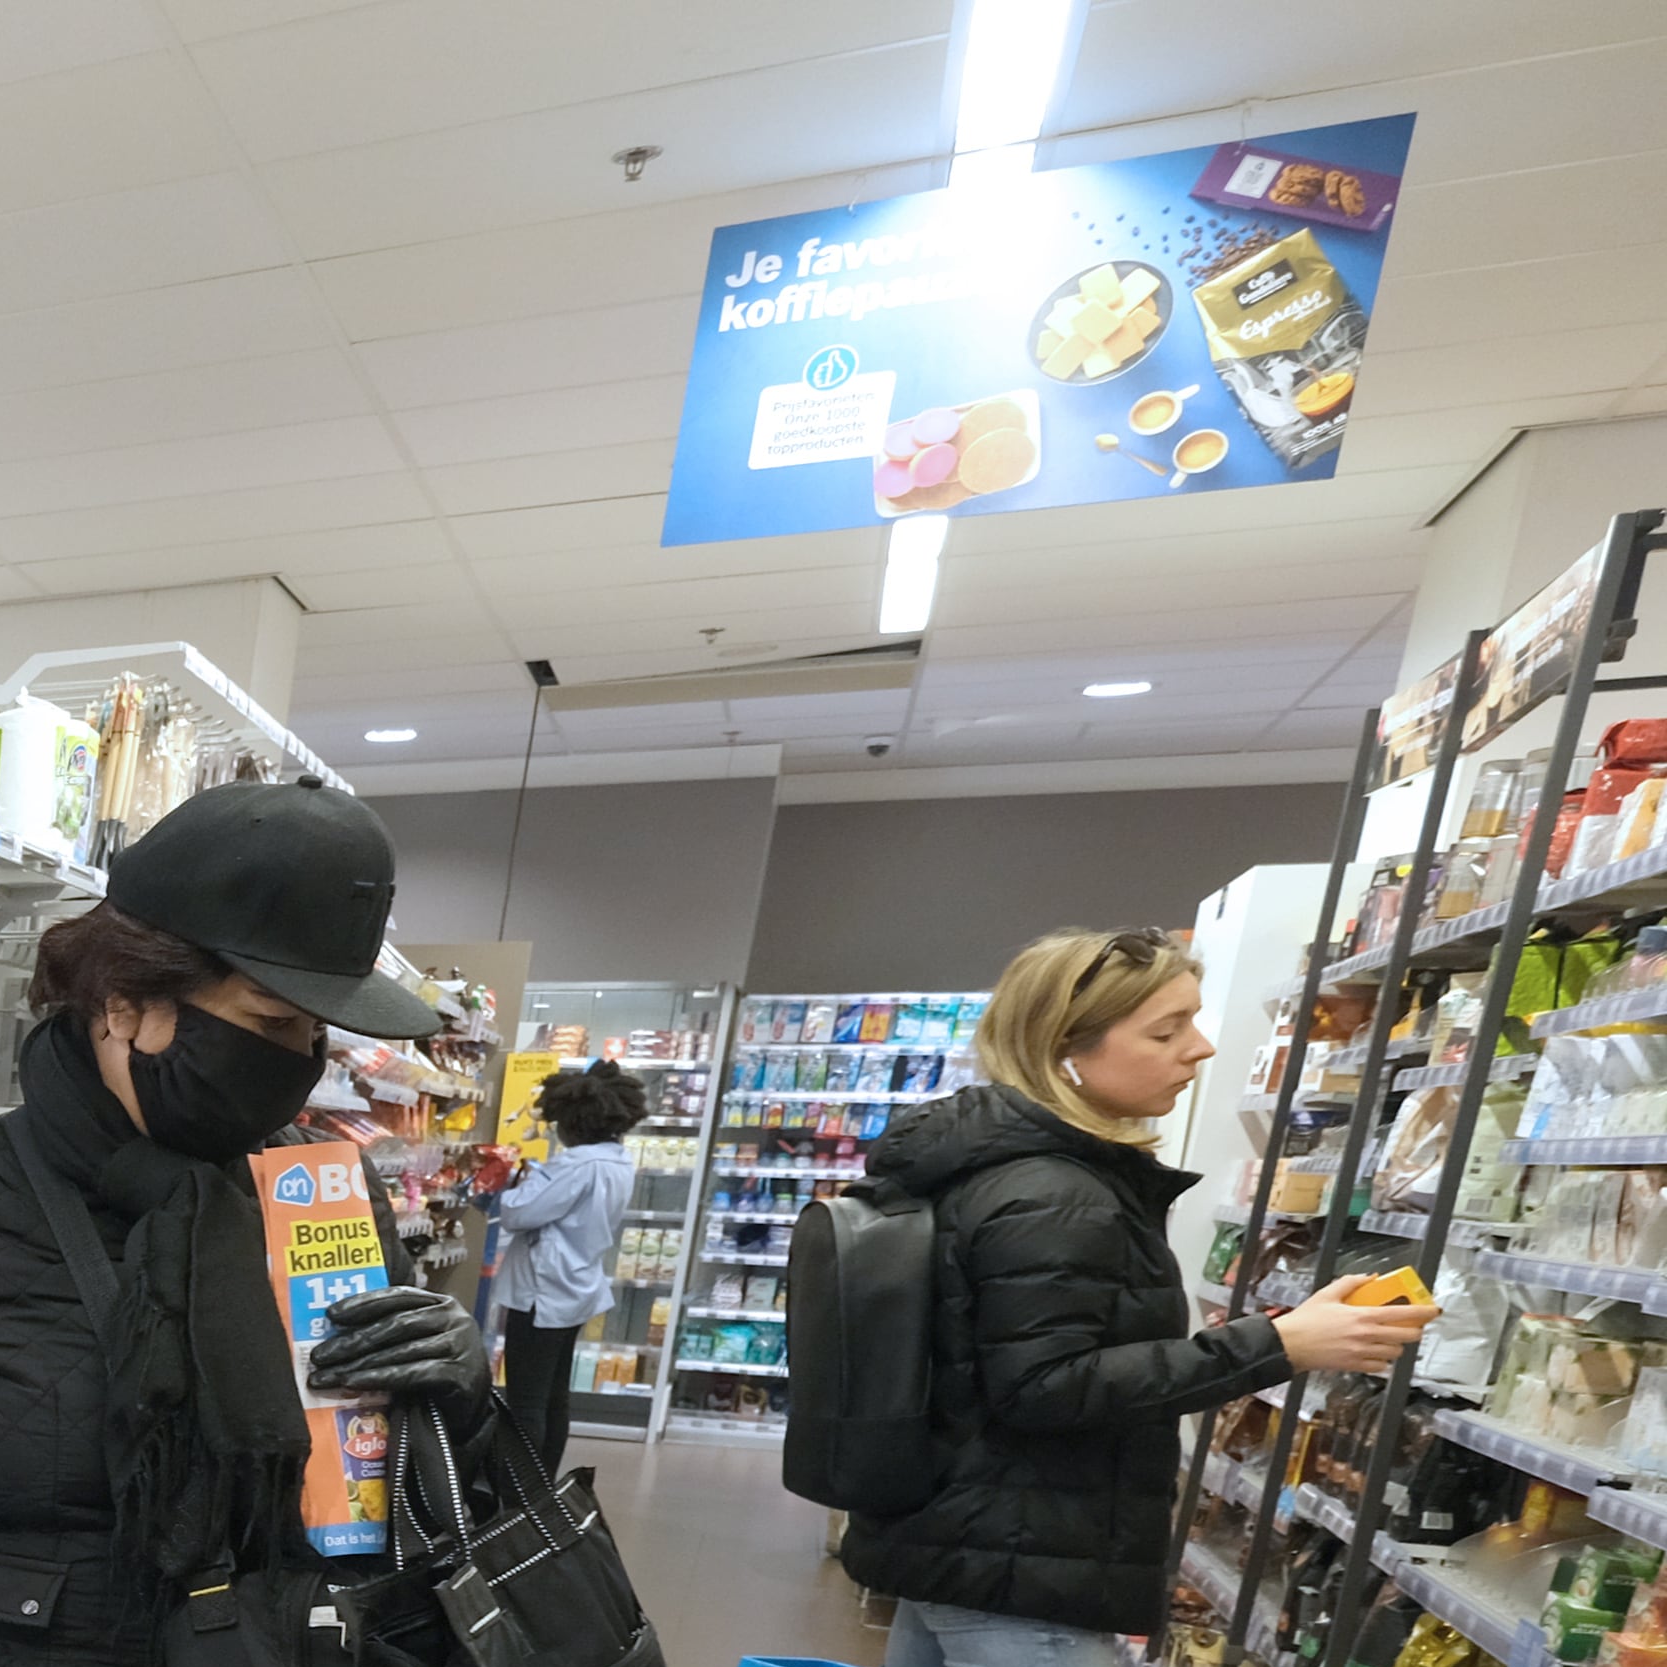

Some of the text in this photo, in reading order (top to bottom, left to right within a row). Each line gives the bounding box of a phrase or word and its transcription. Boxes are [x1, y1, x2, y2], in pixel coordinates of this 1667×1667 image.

[725, 251, 783, 288] Je
[1238, 289, 1323, 343] Espresso
[295, 1220, 371, 1246] Bonus
[289, 1241, 381, 1273] knaller!
[354, 1437, 387, 1455] iglo
[323, 1533, 376, 1547] Dat is het
